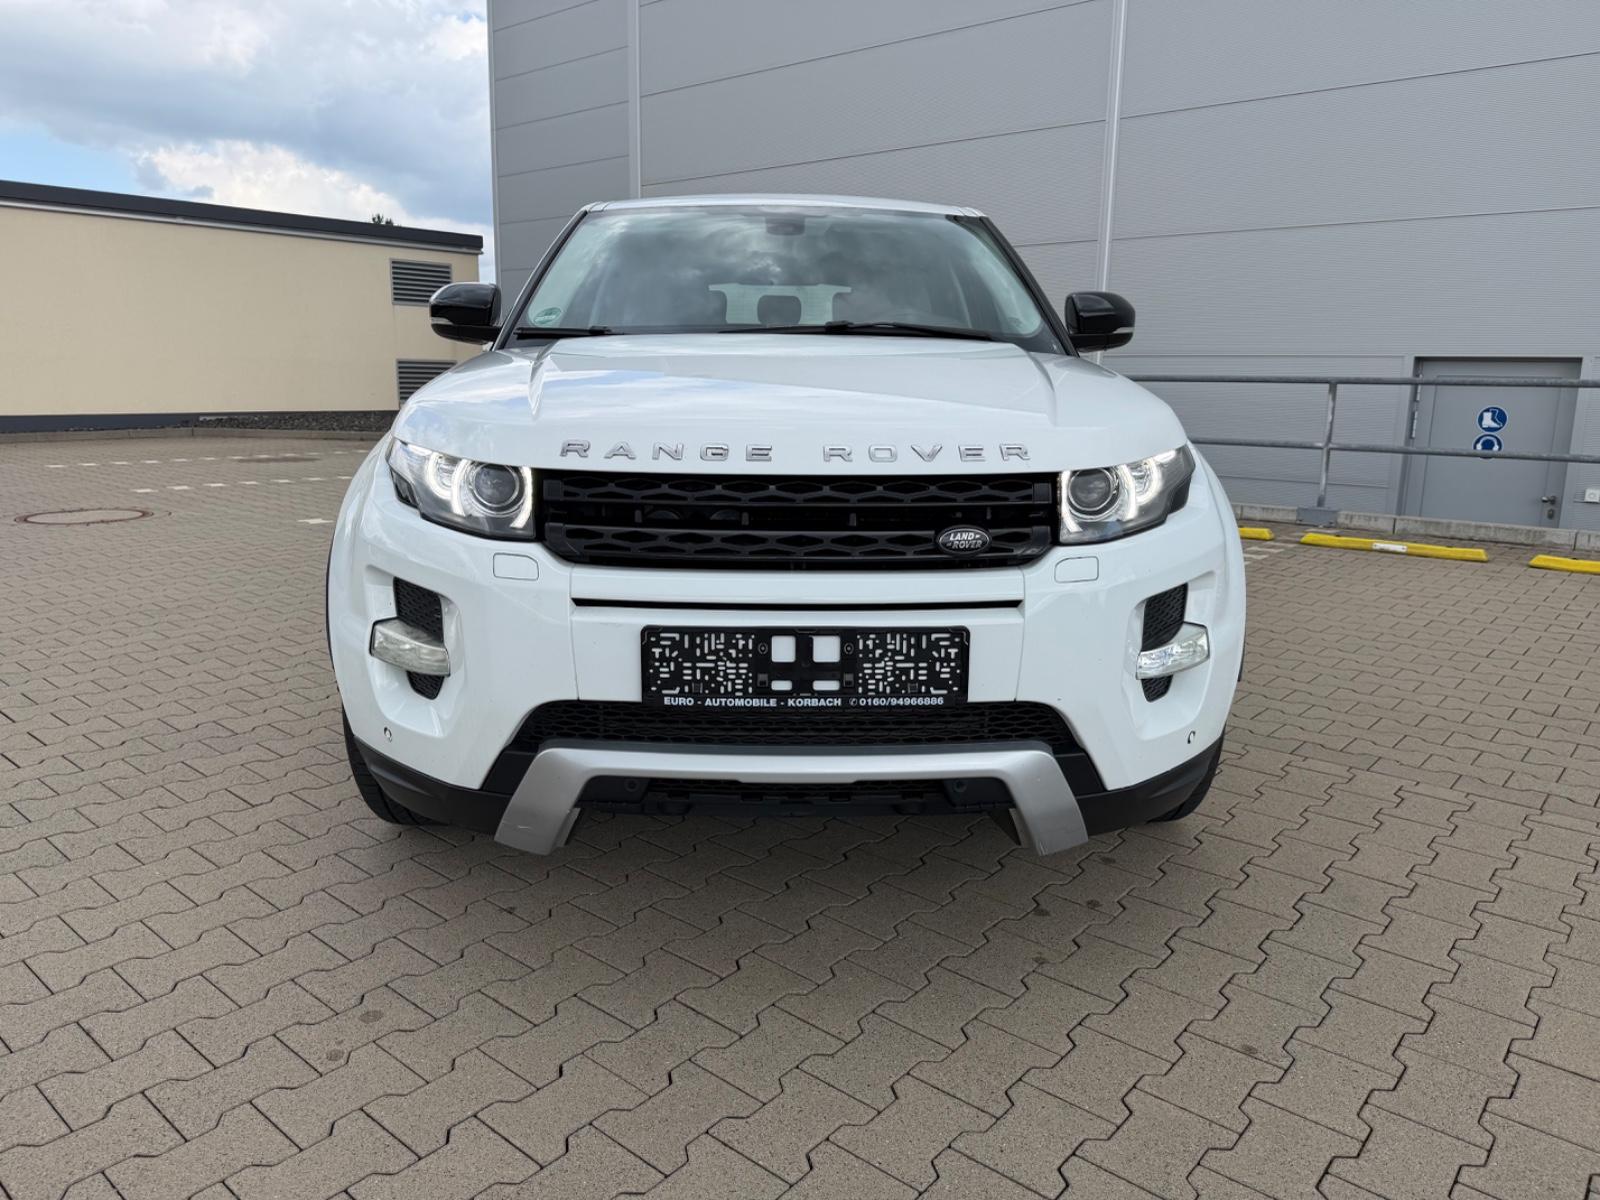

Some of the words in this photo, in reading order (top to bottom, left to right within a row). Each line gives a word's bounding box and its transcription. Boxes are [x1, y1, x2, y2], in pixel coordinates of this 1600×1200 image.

[559, 438, 773, 462] RANGE
[822, 443, 1031, 463] ROVER
[663, 696, 694, 706] EURO
[704, 698, 777, 707] AUTOMOBILE
[787, 698, 842, 707] KORBACH
